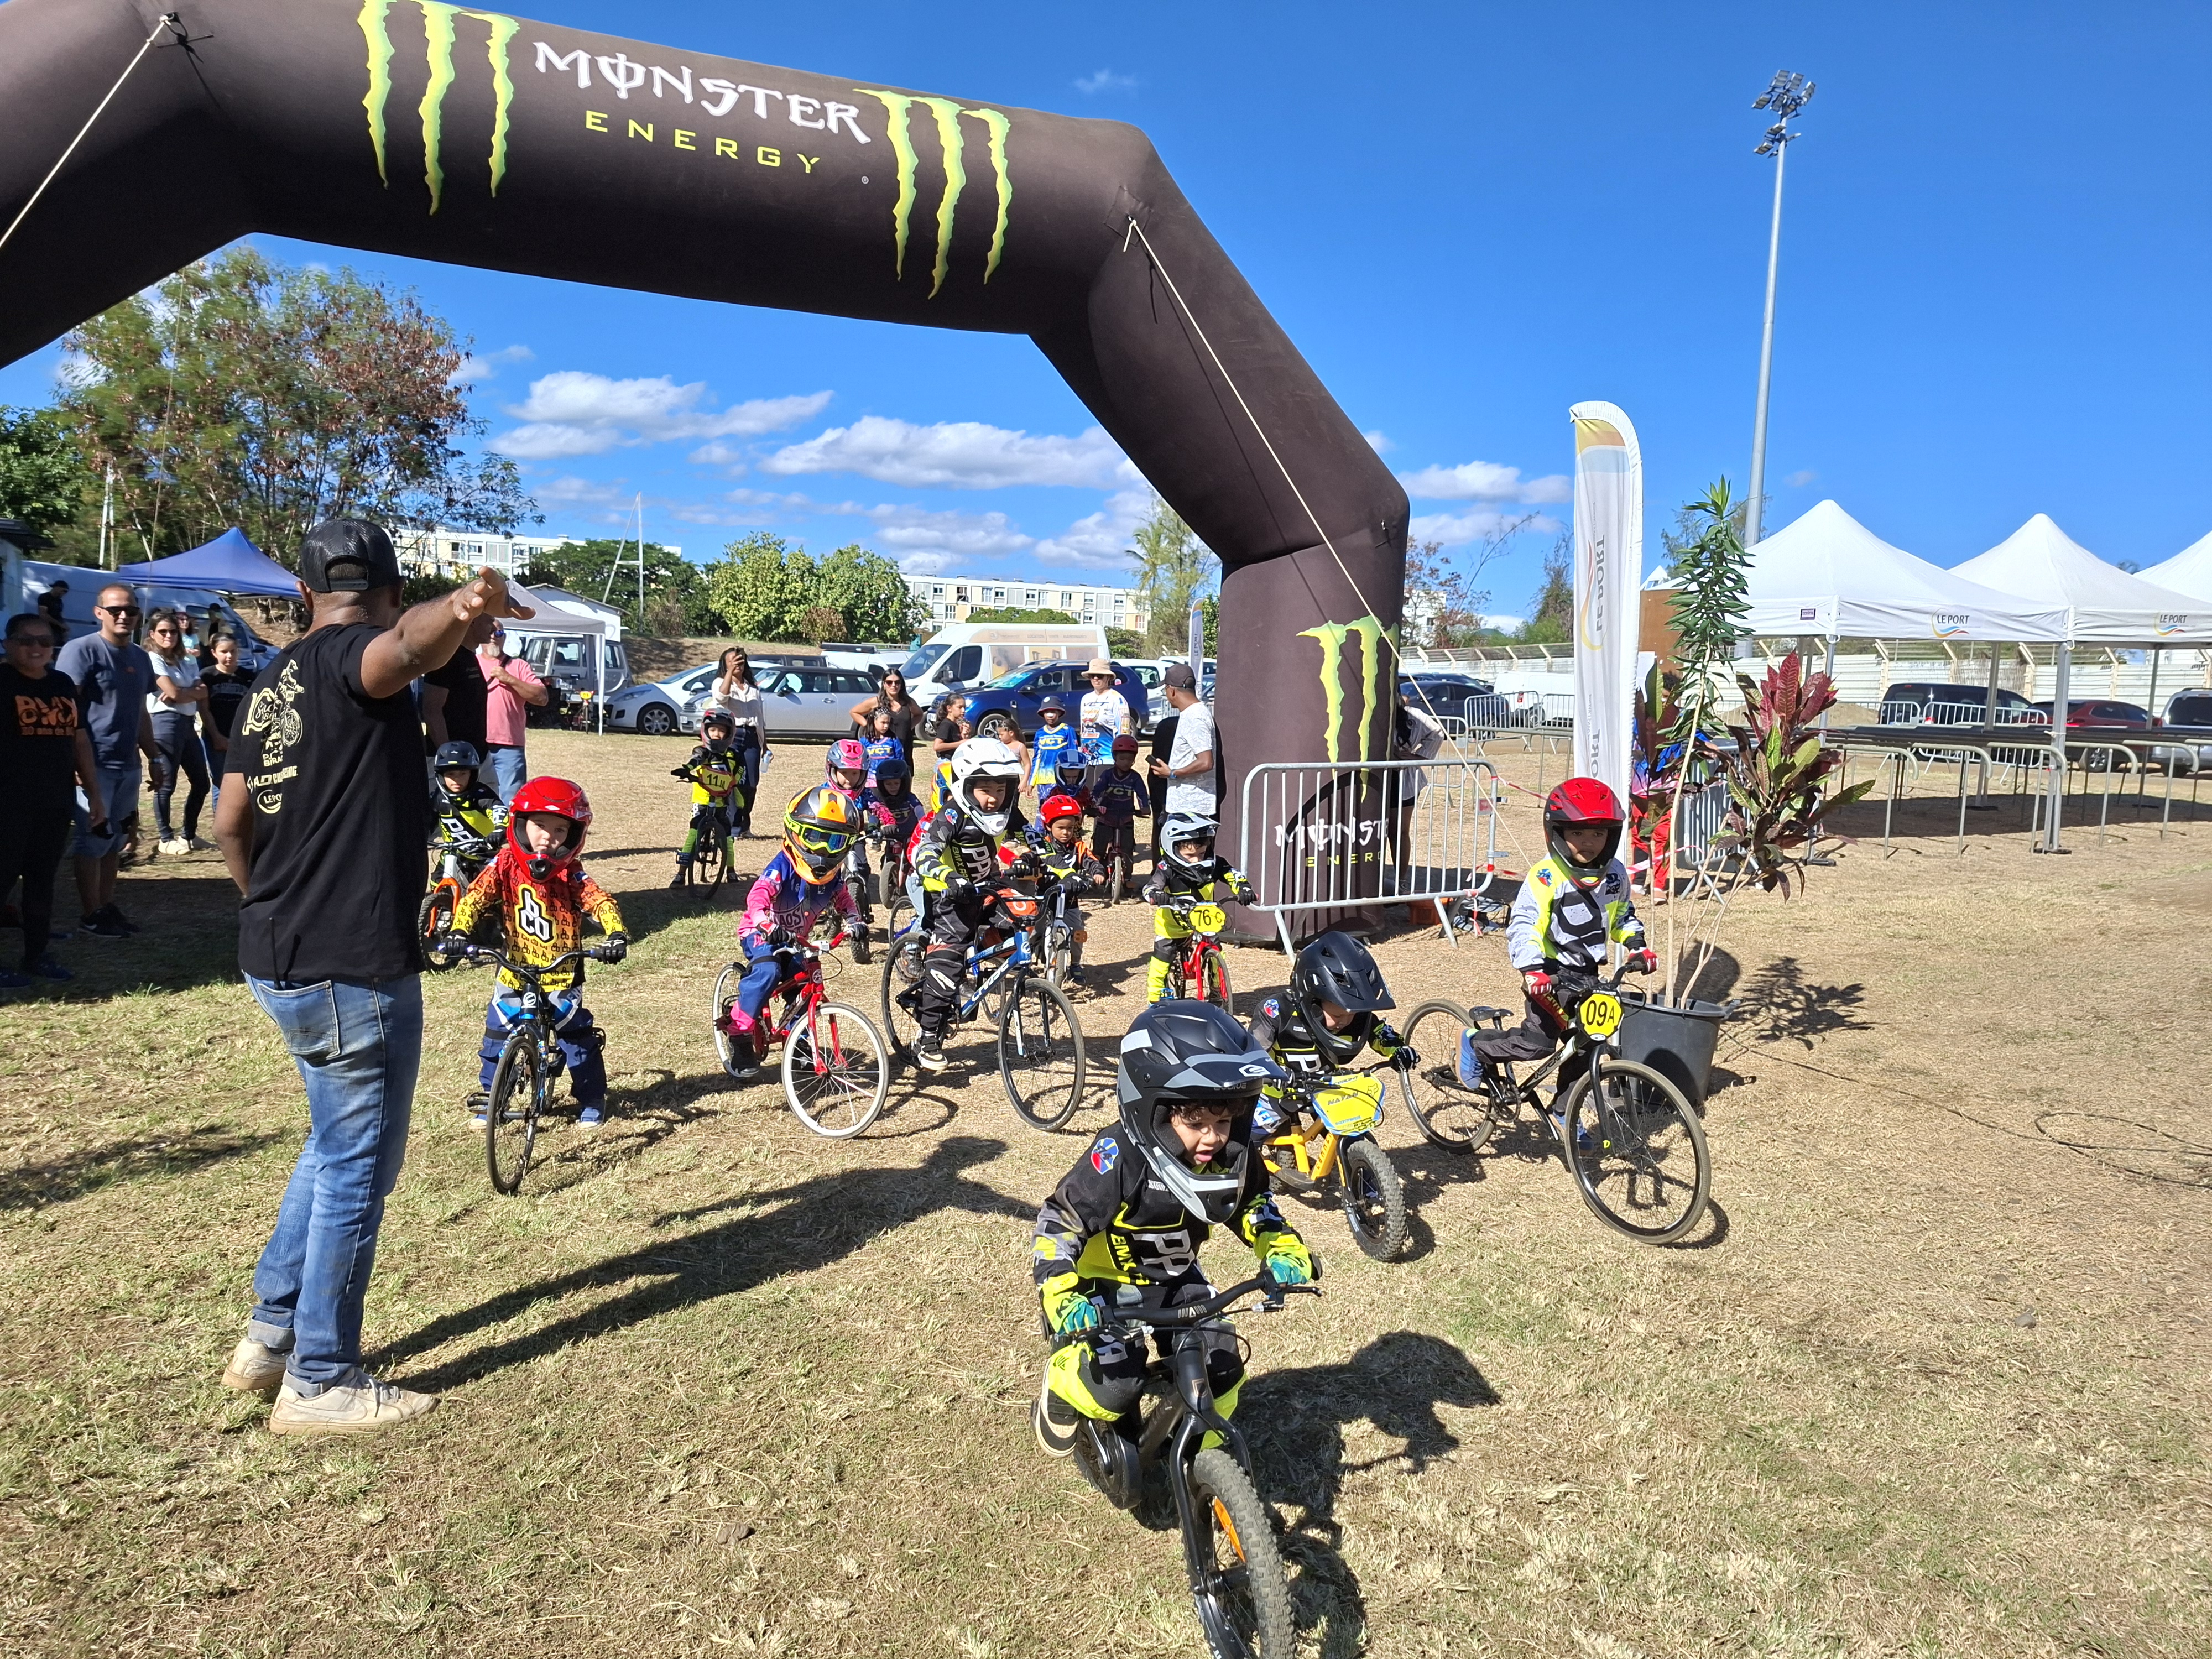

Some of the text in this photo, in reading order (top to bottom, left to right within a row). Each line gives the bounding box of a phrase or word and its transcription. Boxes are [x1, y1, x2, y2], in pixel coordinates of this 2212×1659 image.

[533, 41, 871, 144] MONSTER
[586, 110, 820, 174] ENERGY
[1937, 614, 1970, 624] LE PORT
[2159, 614, 2188, 623] LE PORT
[867, 747, 891, 755] VCT
[1039, 737, 1064, 745] VCT
[951, 843, 964, 869] BMX
[961, 846, 992, 884] PPA
[1328, 1091, 1359, 1106] NAYAN
[1110, 1233, 1137, 1271] BMX
[1131, 1228, 1196, 1277] PP
